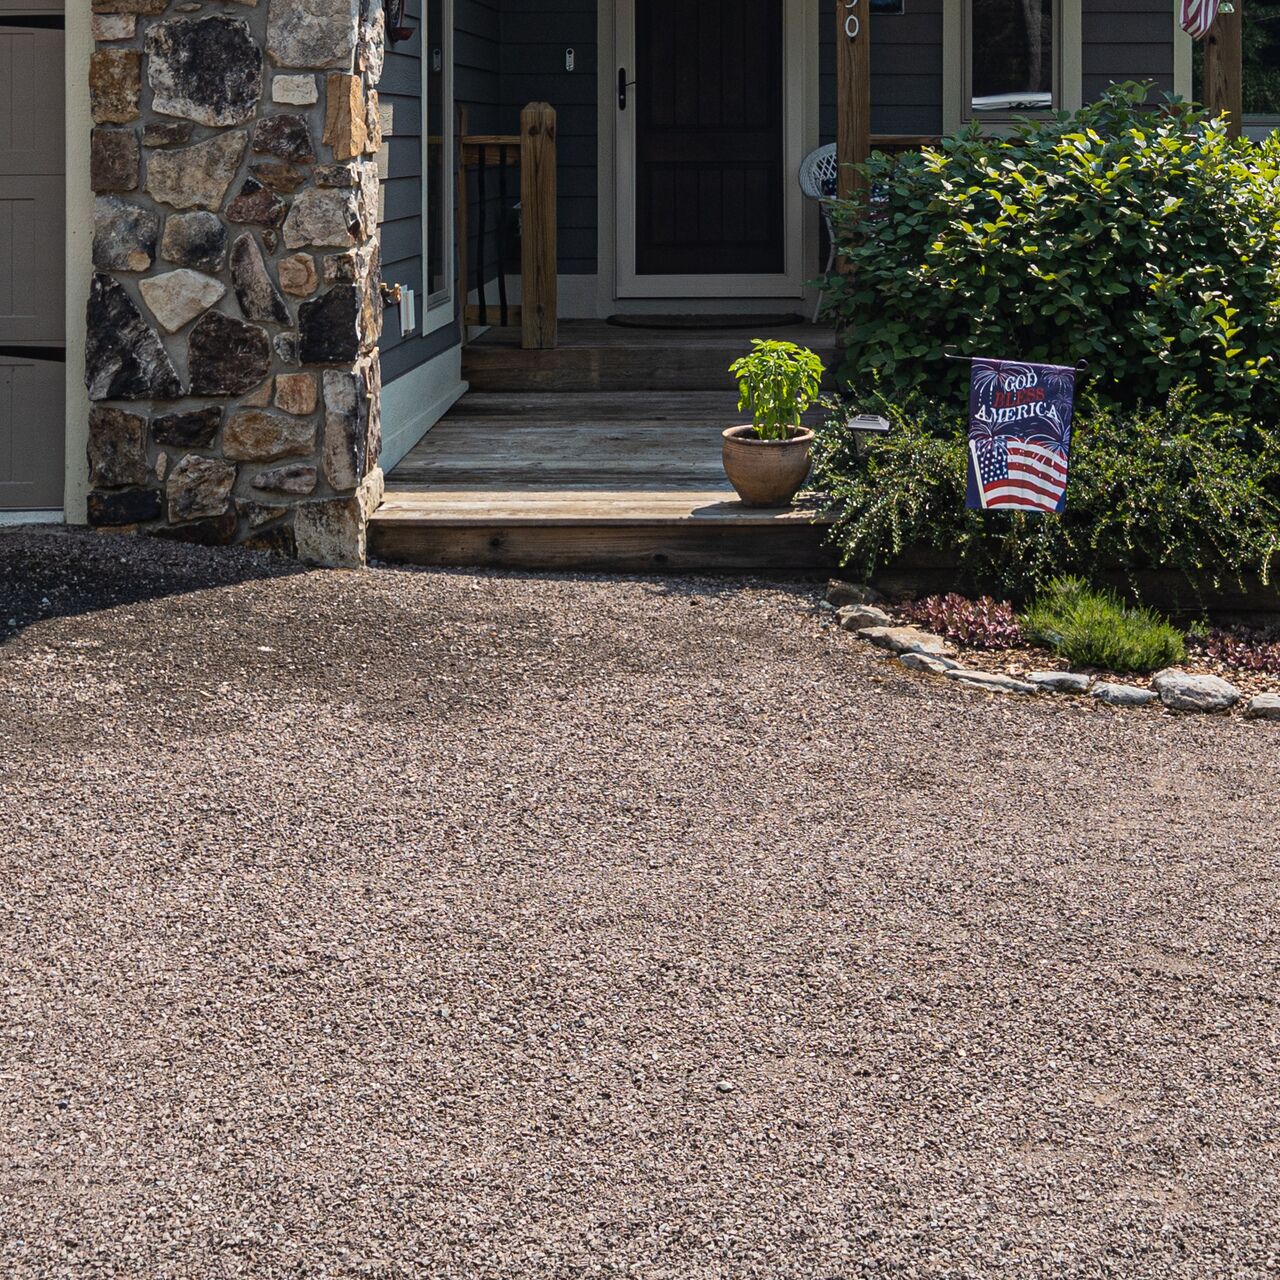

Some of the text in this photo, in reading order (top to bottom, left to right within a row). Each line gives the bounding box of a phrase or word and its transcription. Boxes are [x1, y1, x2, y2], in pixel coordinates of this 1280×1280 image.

[1005, 372, 1038, 392] GOD
[993, 387, 1045, 408] BLESS
[975, 401, 1060, 423] AMERICA
